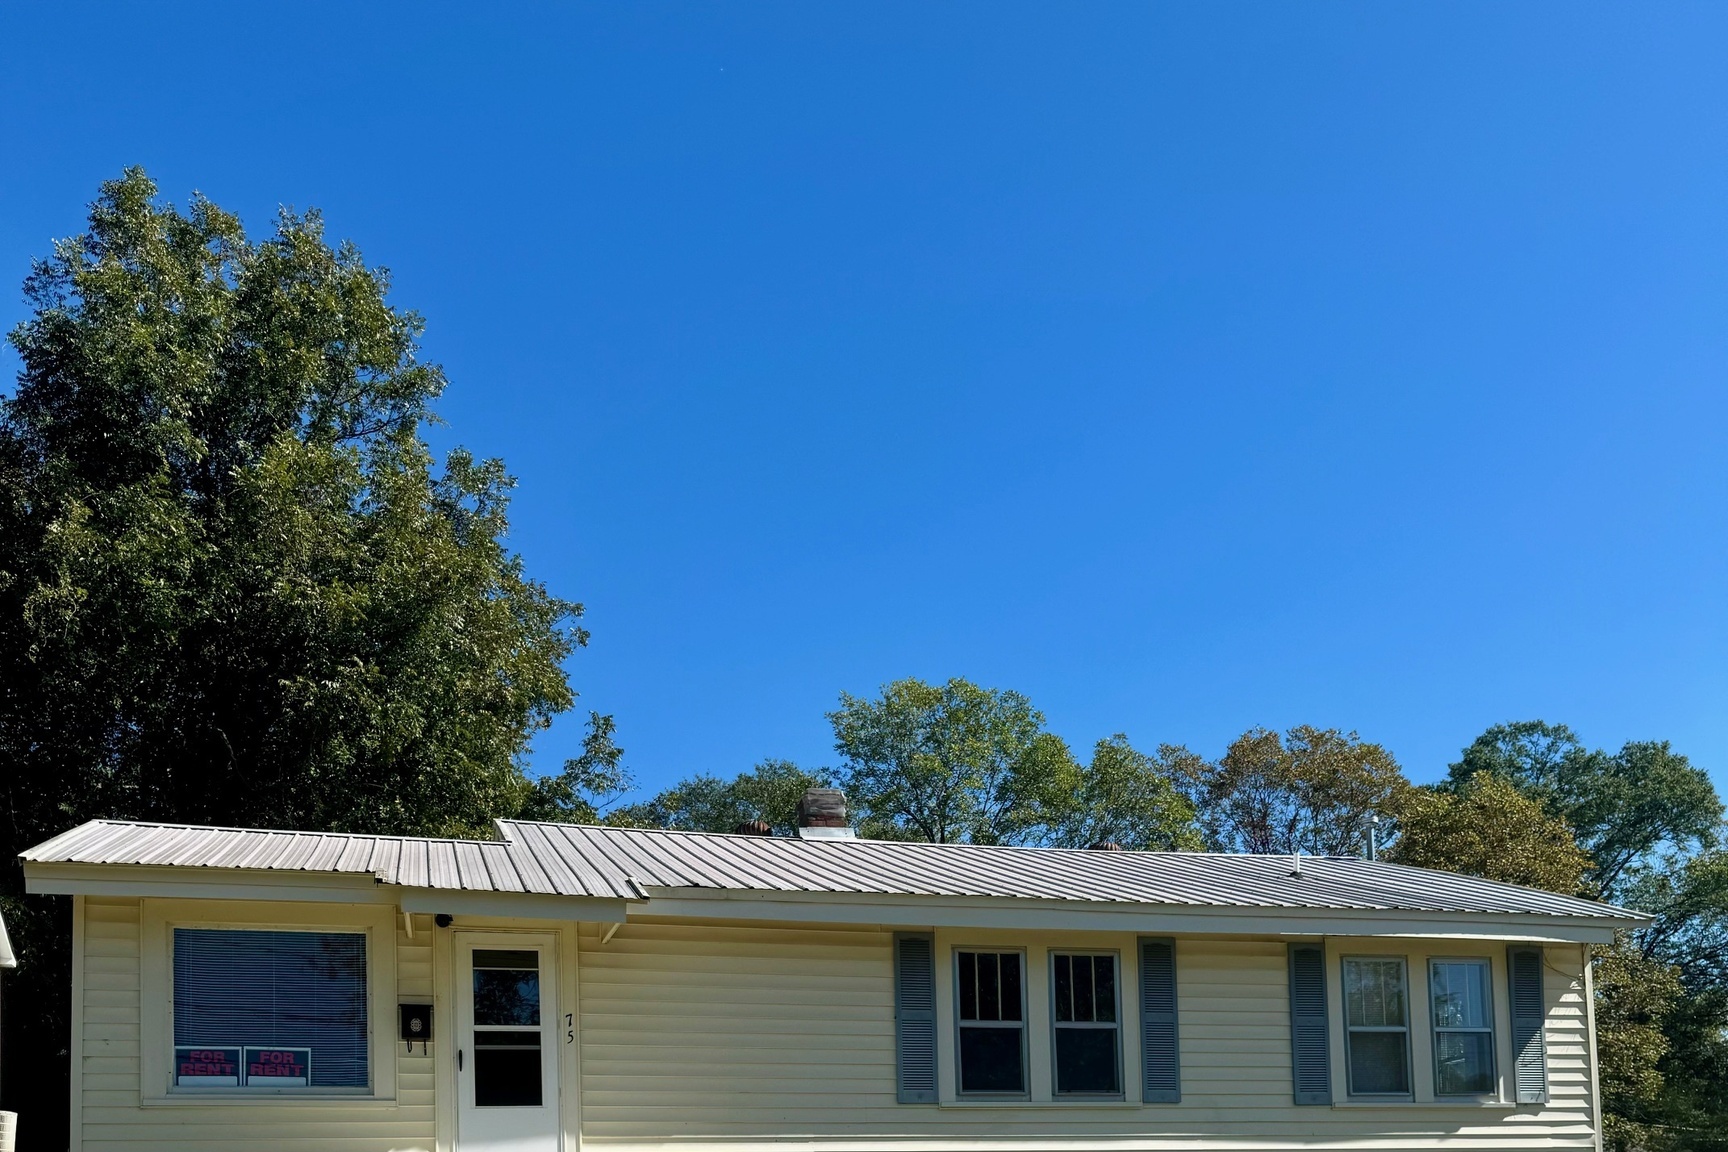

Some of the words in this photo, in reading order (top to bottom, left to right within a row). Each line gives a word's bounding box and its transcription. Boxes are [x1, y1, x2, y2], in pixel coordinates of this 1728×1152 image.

[565, 1013, 574, 1044] 75
[189, 1051, 225, 1063] FOR
[259, 1051, 295, 1064] FOR
[180, 1063, 235, 1076] RENT
[249, 1064, 304, 1076] RENT
